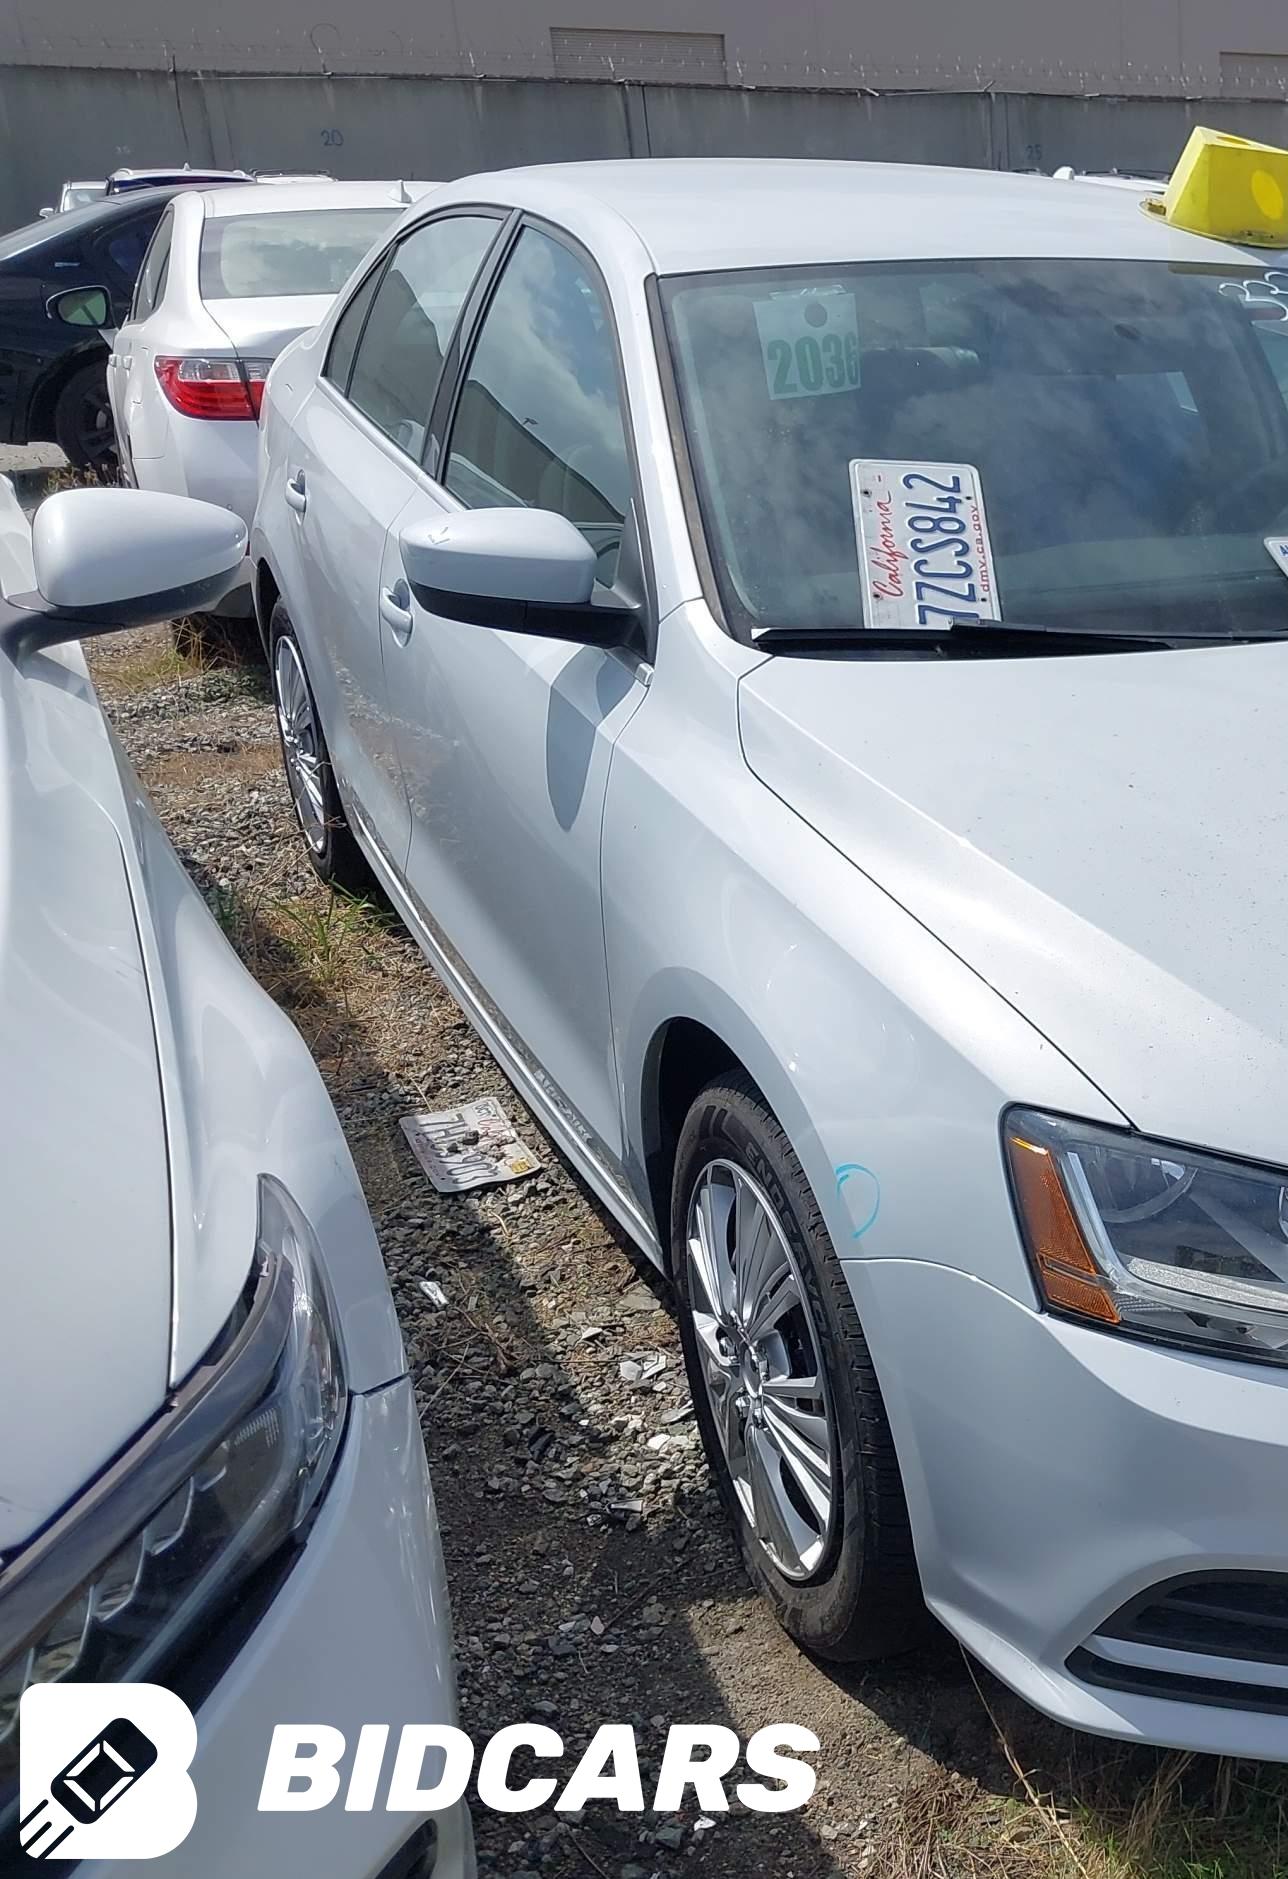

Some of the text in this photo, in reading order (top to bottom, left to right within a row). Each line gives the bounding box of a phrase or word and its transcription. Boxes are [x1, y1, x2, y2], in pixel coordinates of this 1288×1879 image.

[320, 129, 345, 147] 20
[869, 490, 909, 597] California
[902, 473, 980, 625] 7ZCS842
